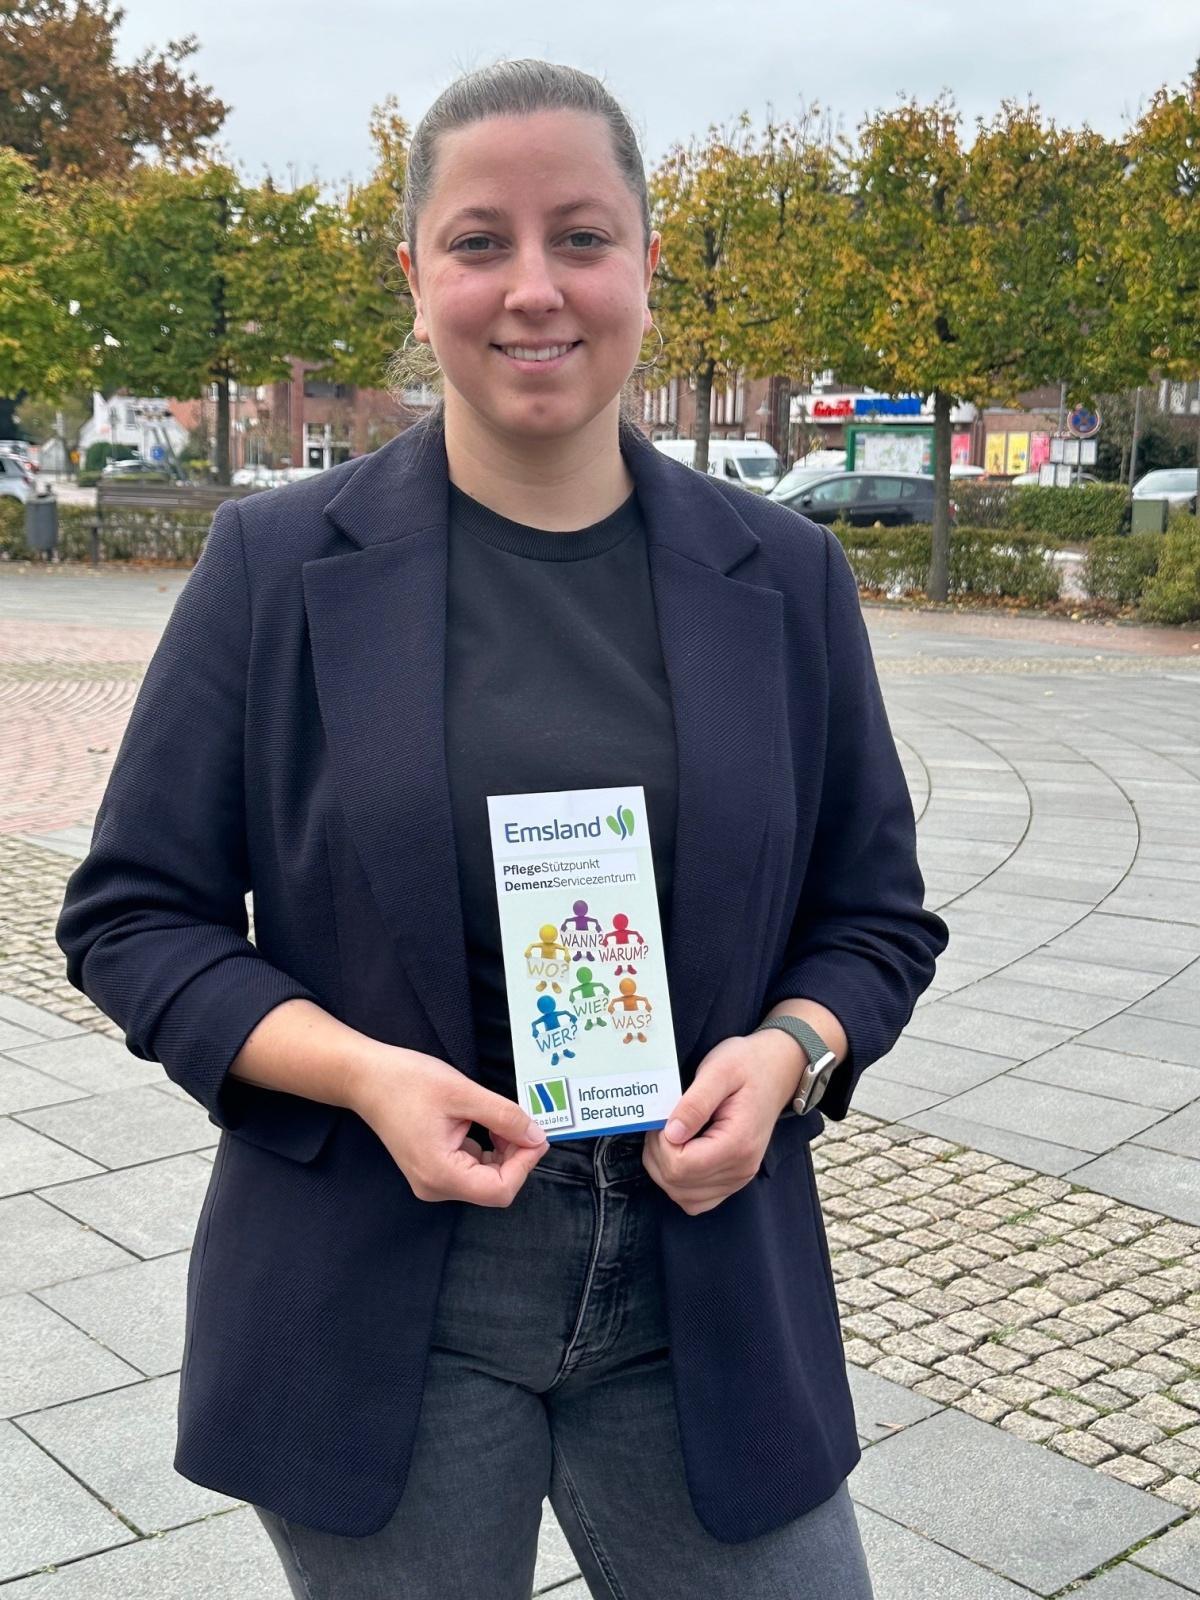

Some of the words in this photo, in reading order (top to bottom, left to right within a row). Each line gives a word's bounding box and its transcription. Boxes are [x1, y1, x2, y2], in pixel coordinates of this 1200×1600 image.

[504, 816, 601, 843] Emsland
[503, 859, 600, 876] PflegeStützpunkt
[504, 872, 636, 891] DemenzServicezentrum
[560, 933, 604, 948] WANN?
[599, 945, 649, 963] WARUM?
[527, 961, 569, 978] WO?
[573, 998, 609, 1017] WIE?
[612, 1014, 652, 1030] WAS?
[536, 1024, 578, 1053] WER?
[578, 1081, 658, 1102] Information
[580, 1104, 645, 1121] Beratung
